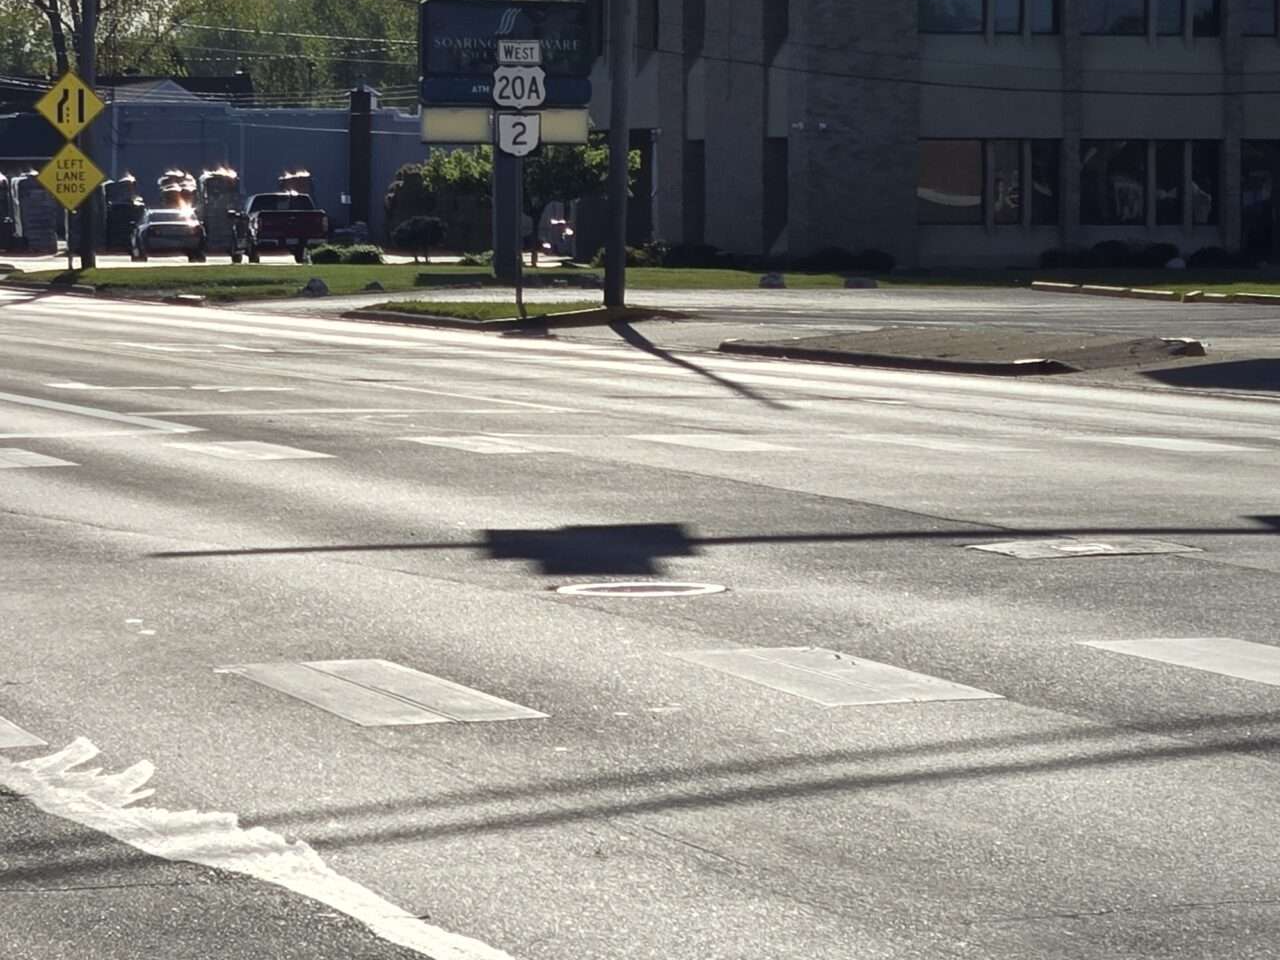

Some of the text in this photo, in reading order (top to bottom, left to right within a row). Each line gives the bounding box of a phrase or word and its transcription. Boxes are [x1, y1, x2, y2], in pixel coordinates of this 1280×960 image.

[503, 44, 536, 60] WEST
[498, 75, 541, 100] 20A
[511, 121, 528, 146] 2
[56, 159, 84, 170] LEFT
[55, 171, 87, 182] LANE
[56, 183, 87, 194] ENDS
